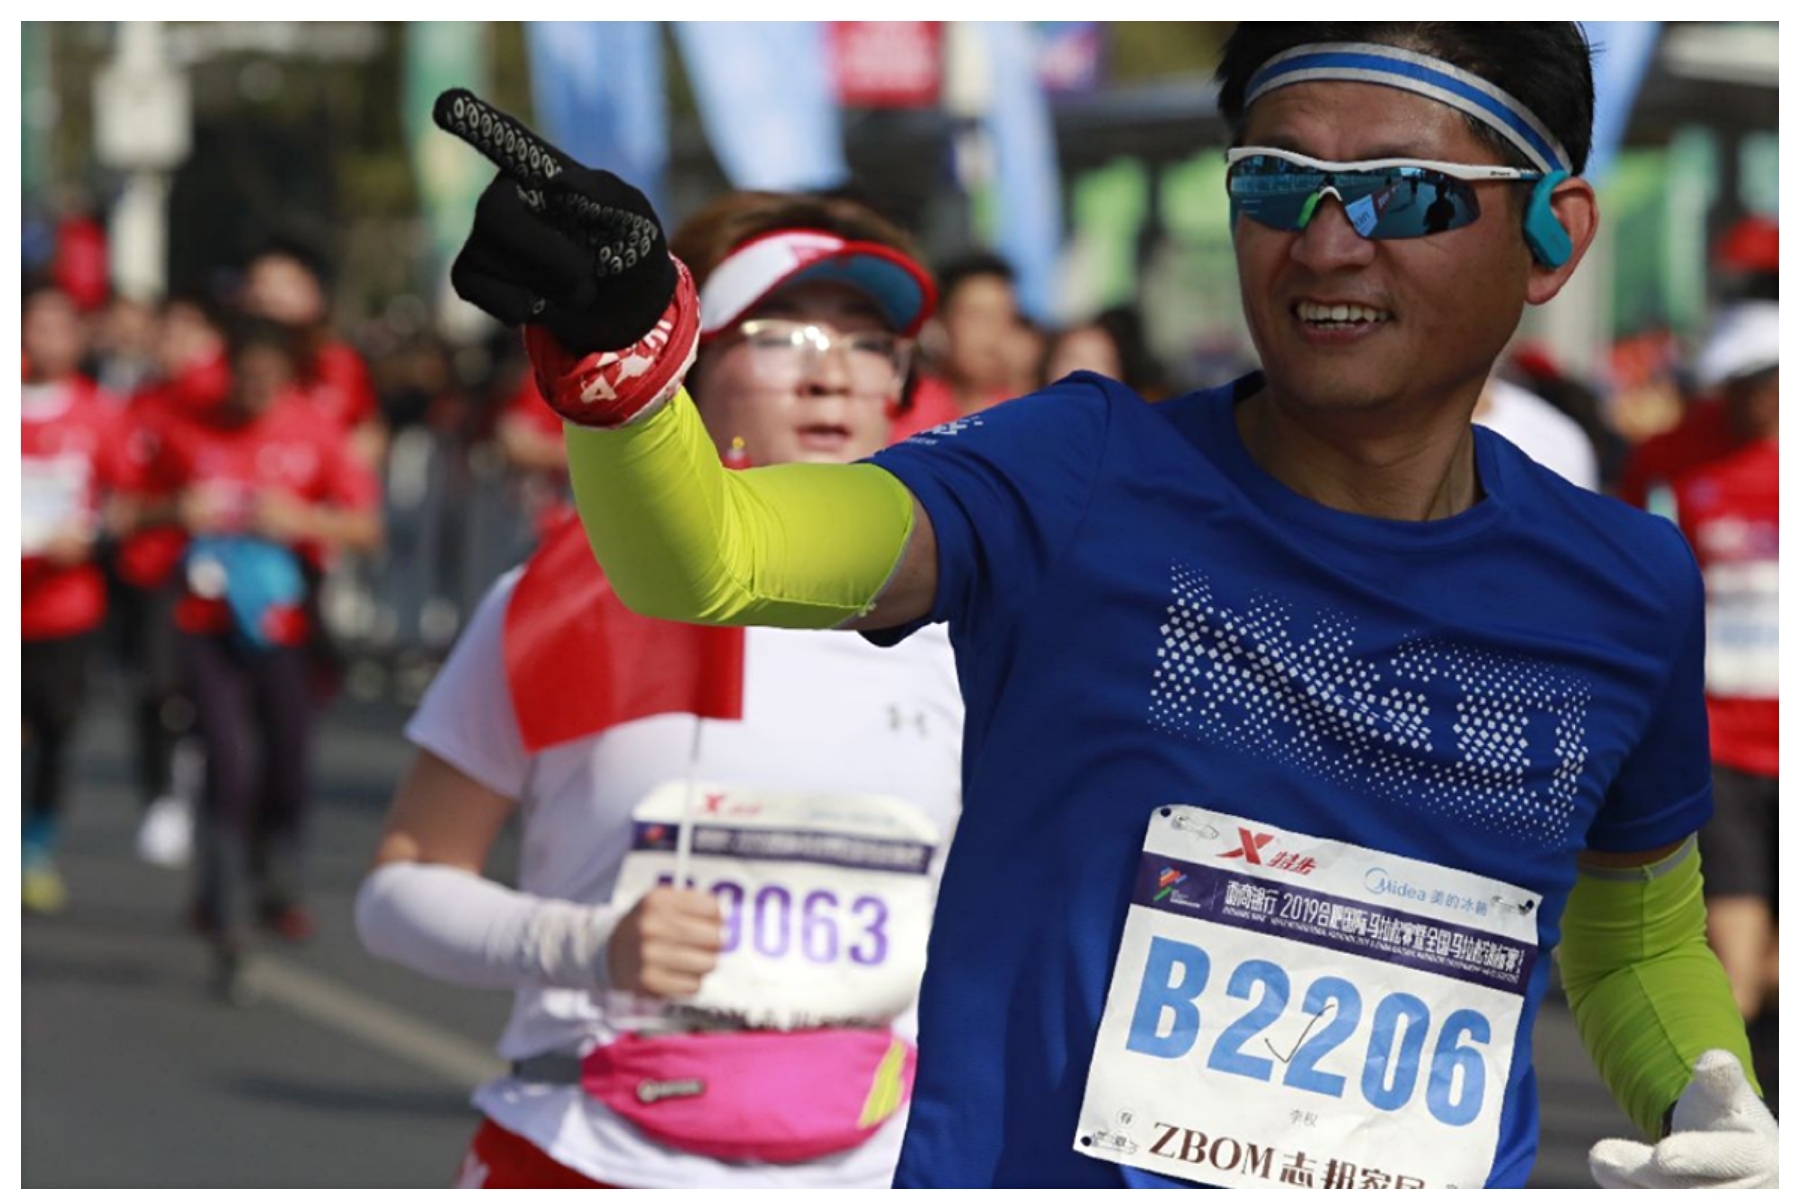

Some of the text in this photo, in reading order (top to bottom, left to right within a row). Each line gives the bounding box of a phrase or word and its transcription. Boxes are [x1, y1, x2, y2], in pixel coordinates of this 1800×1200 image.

[657, 875, 890, 966] 9063
[1365, 868, 1426, 900] Midea
[1126, 936, 1492, 1126] B2206
[1149, 1122, 1276, 1180] ZBOM
